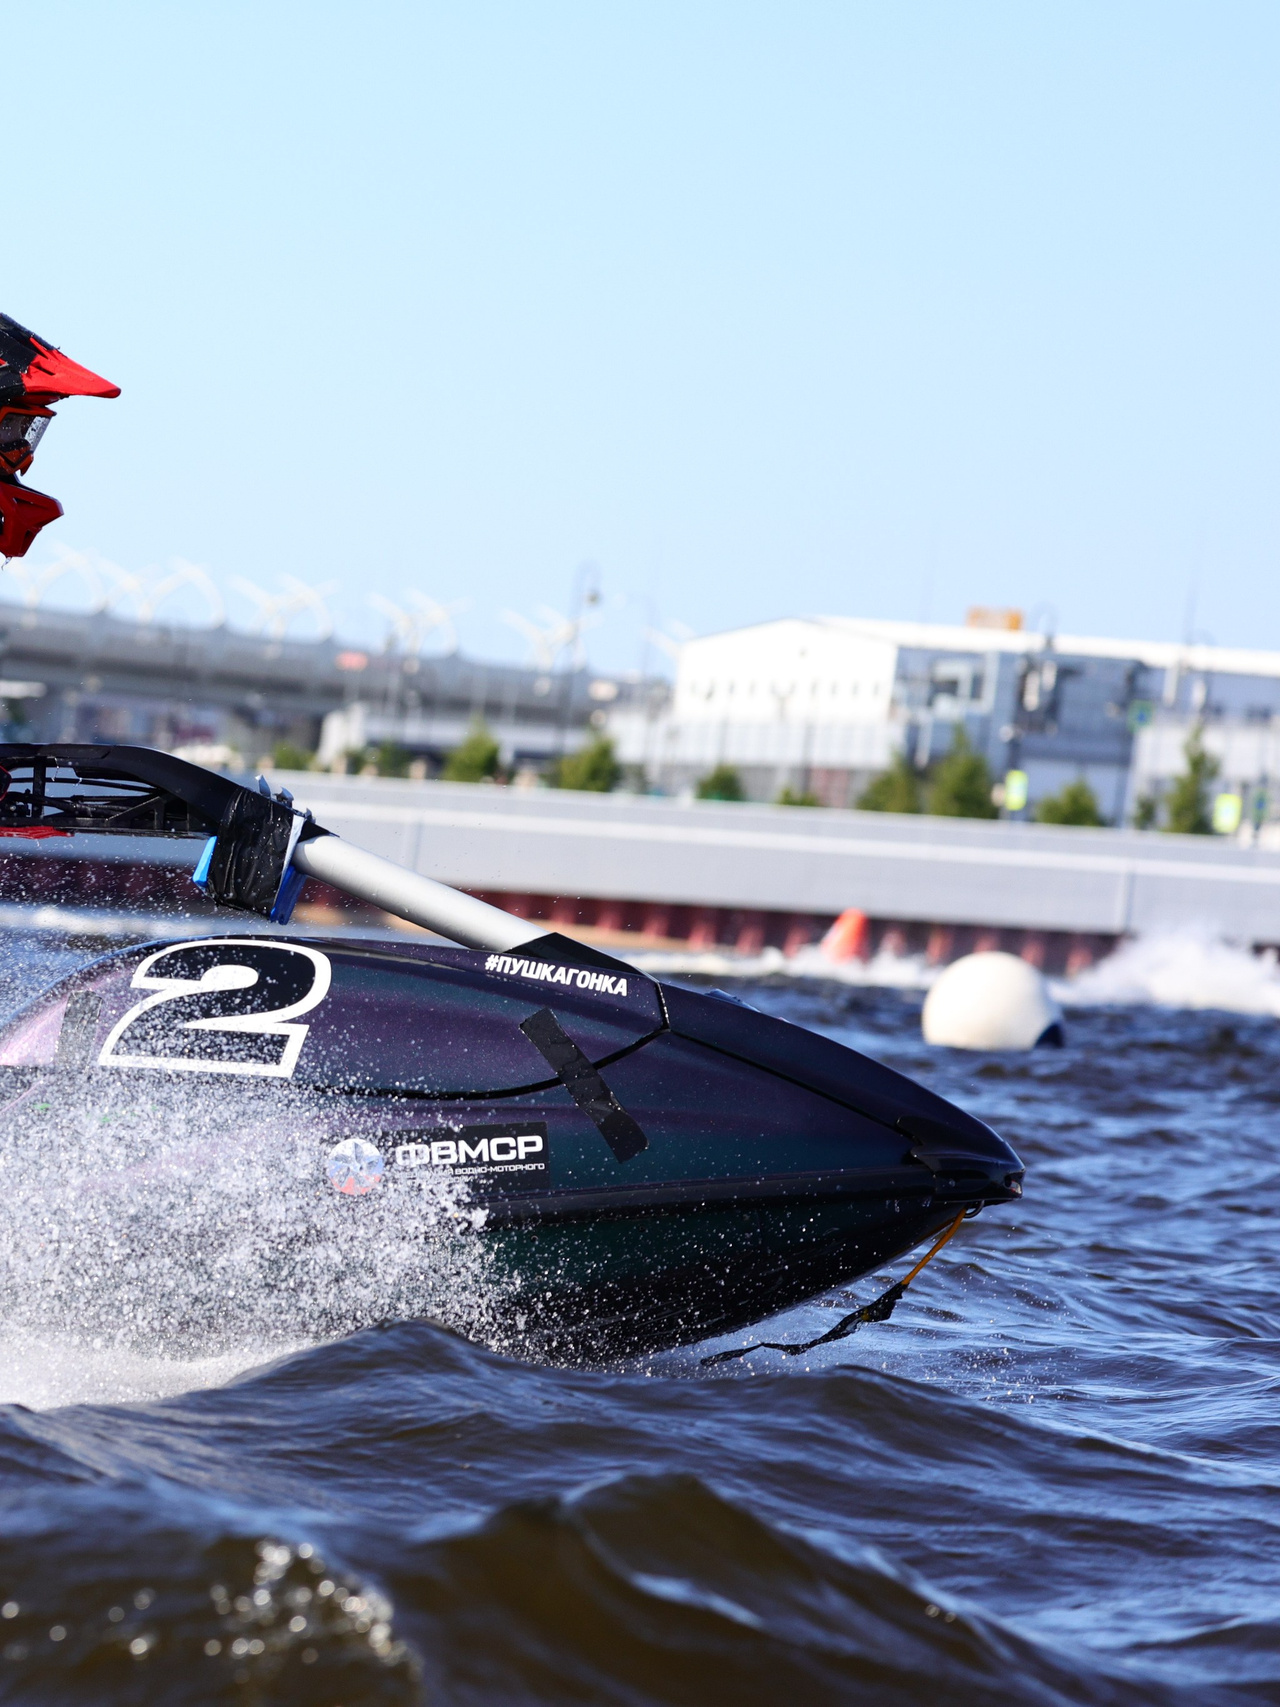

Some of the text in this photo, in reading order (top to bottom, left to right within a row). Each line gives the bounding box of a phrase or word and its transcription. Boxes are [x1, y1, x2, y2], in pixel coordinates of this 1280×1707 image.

[484, 954, 628, 997] #ПУШКАГОНКА
[97, 938, 332, 1079] 2
[395, 1135, 544, 1168] ФВМСР
[454, 1162, 546, 1176] ВОДНО-МОТОРНОГО
